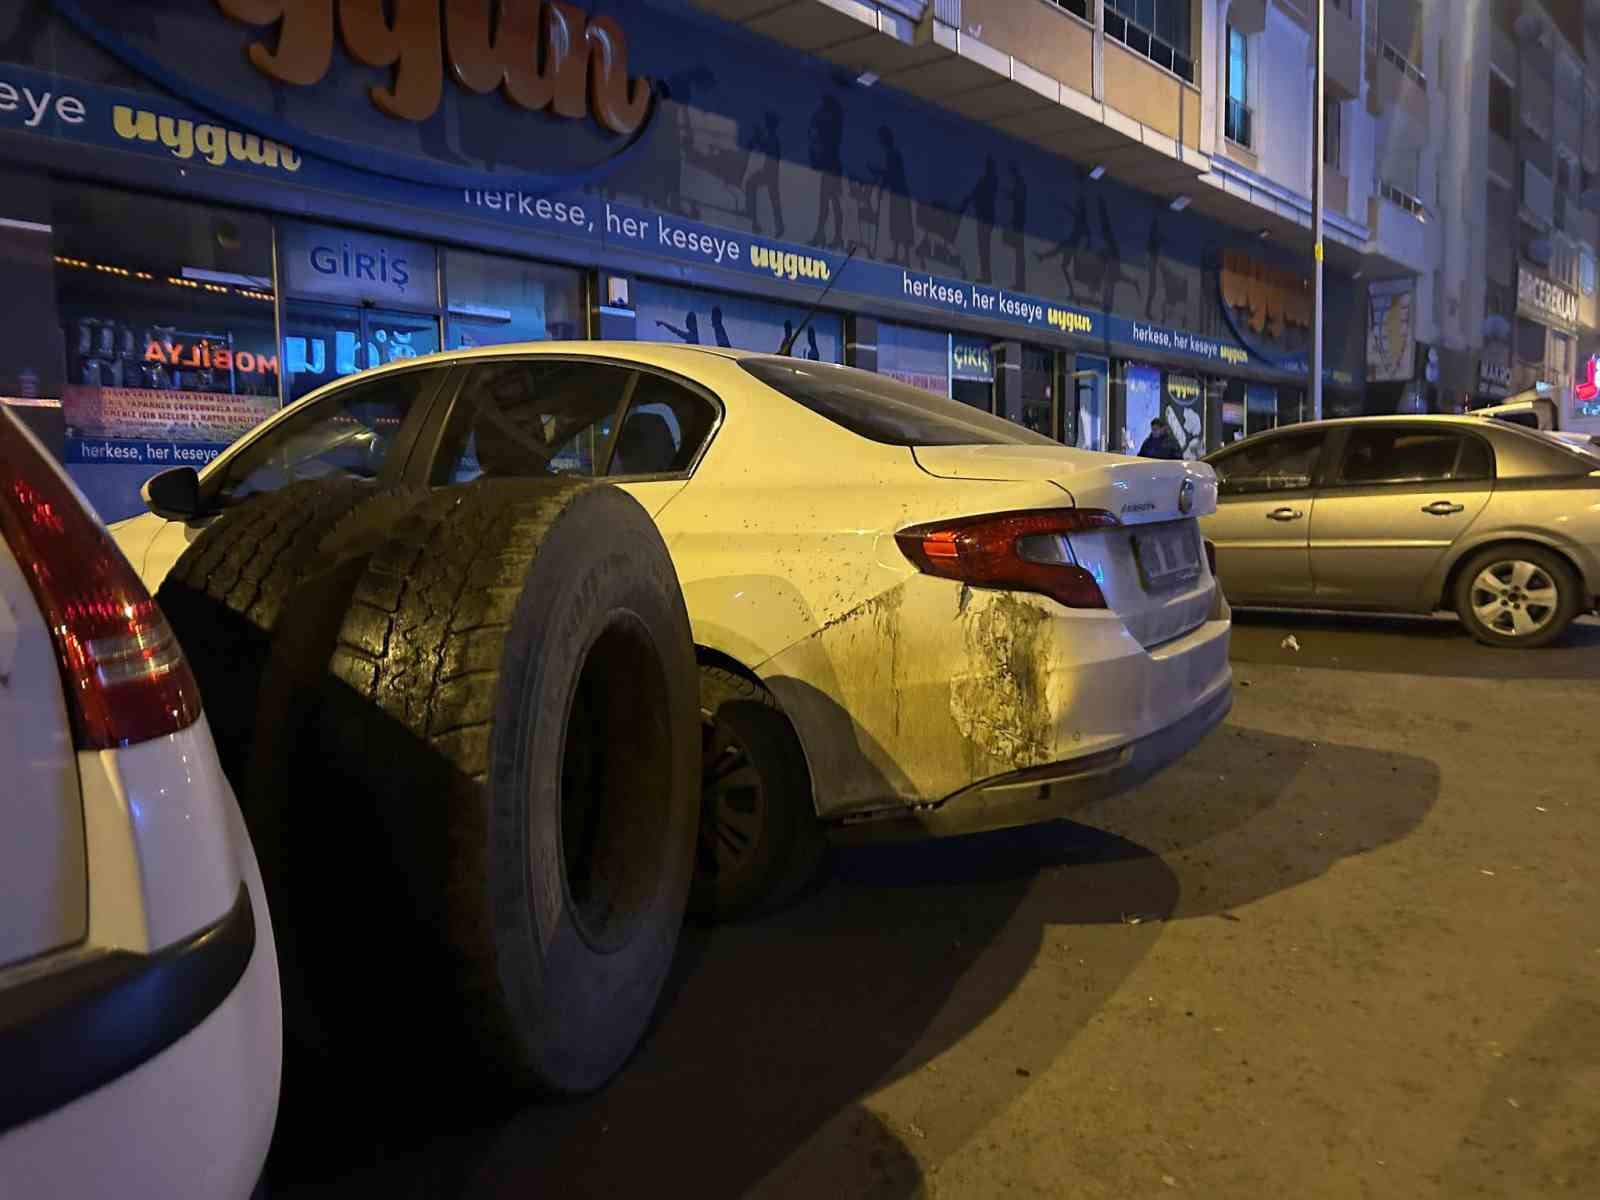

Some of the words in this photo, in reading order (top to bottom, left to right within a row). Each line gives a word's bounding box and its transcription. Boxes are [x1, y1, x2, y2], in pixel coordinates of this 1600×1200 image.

[112, 105, 302, 171] uygun
[310, 243, 409, 294] GİRİŞ
[605, 203, 648, 239] her
[658, 215, 740, 263] keseye
[750, 245, 831, 281] uygun
[903, 271, 967, 308] herkese,
[973, 286, 995, 311] her
[1000, 291, 1042, 323] keseye
[1047, 307, 1092, 332] uygun
[1133, 321, 1172, 348] herkese,
[1174, 331, 1188, 349] her
[1190, 334, 1218, 358] keseye
[81, 441, 143, 461] herkese,
[146, 444, 169, 460] her
[174, 444, 218, 463] keseye
